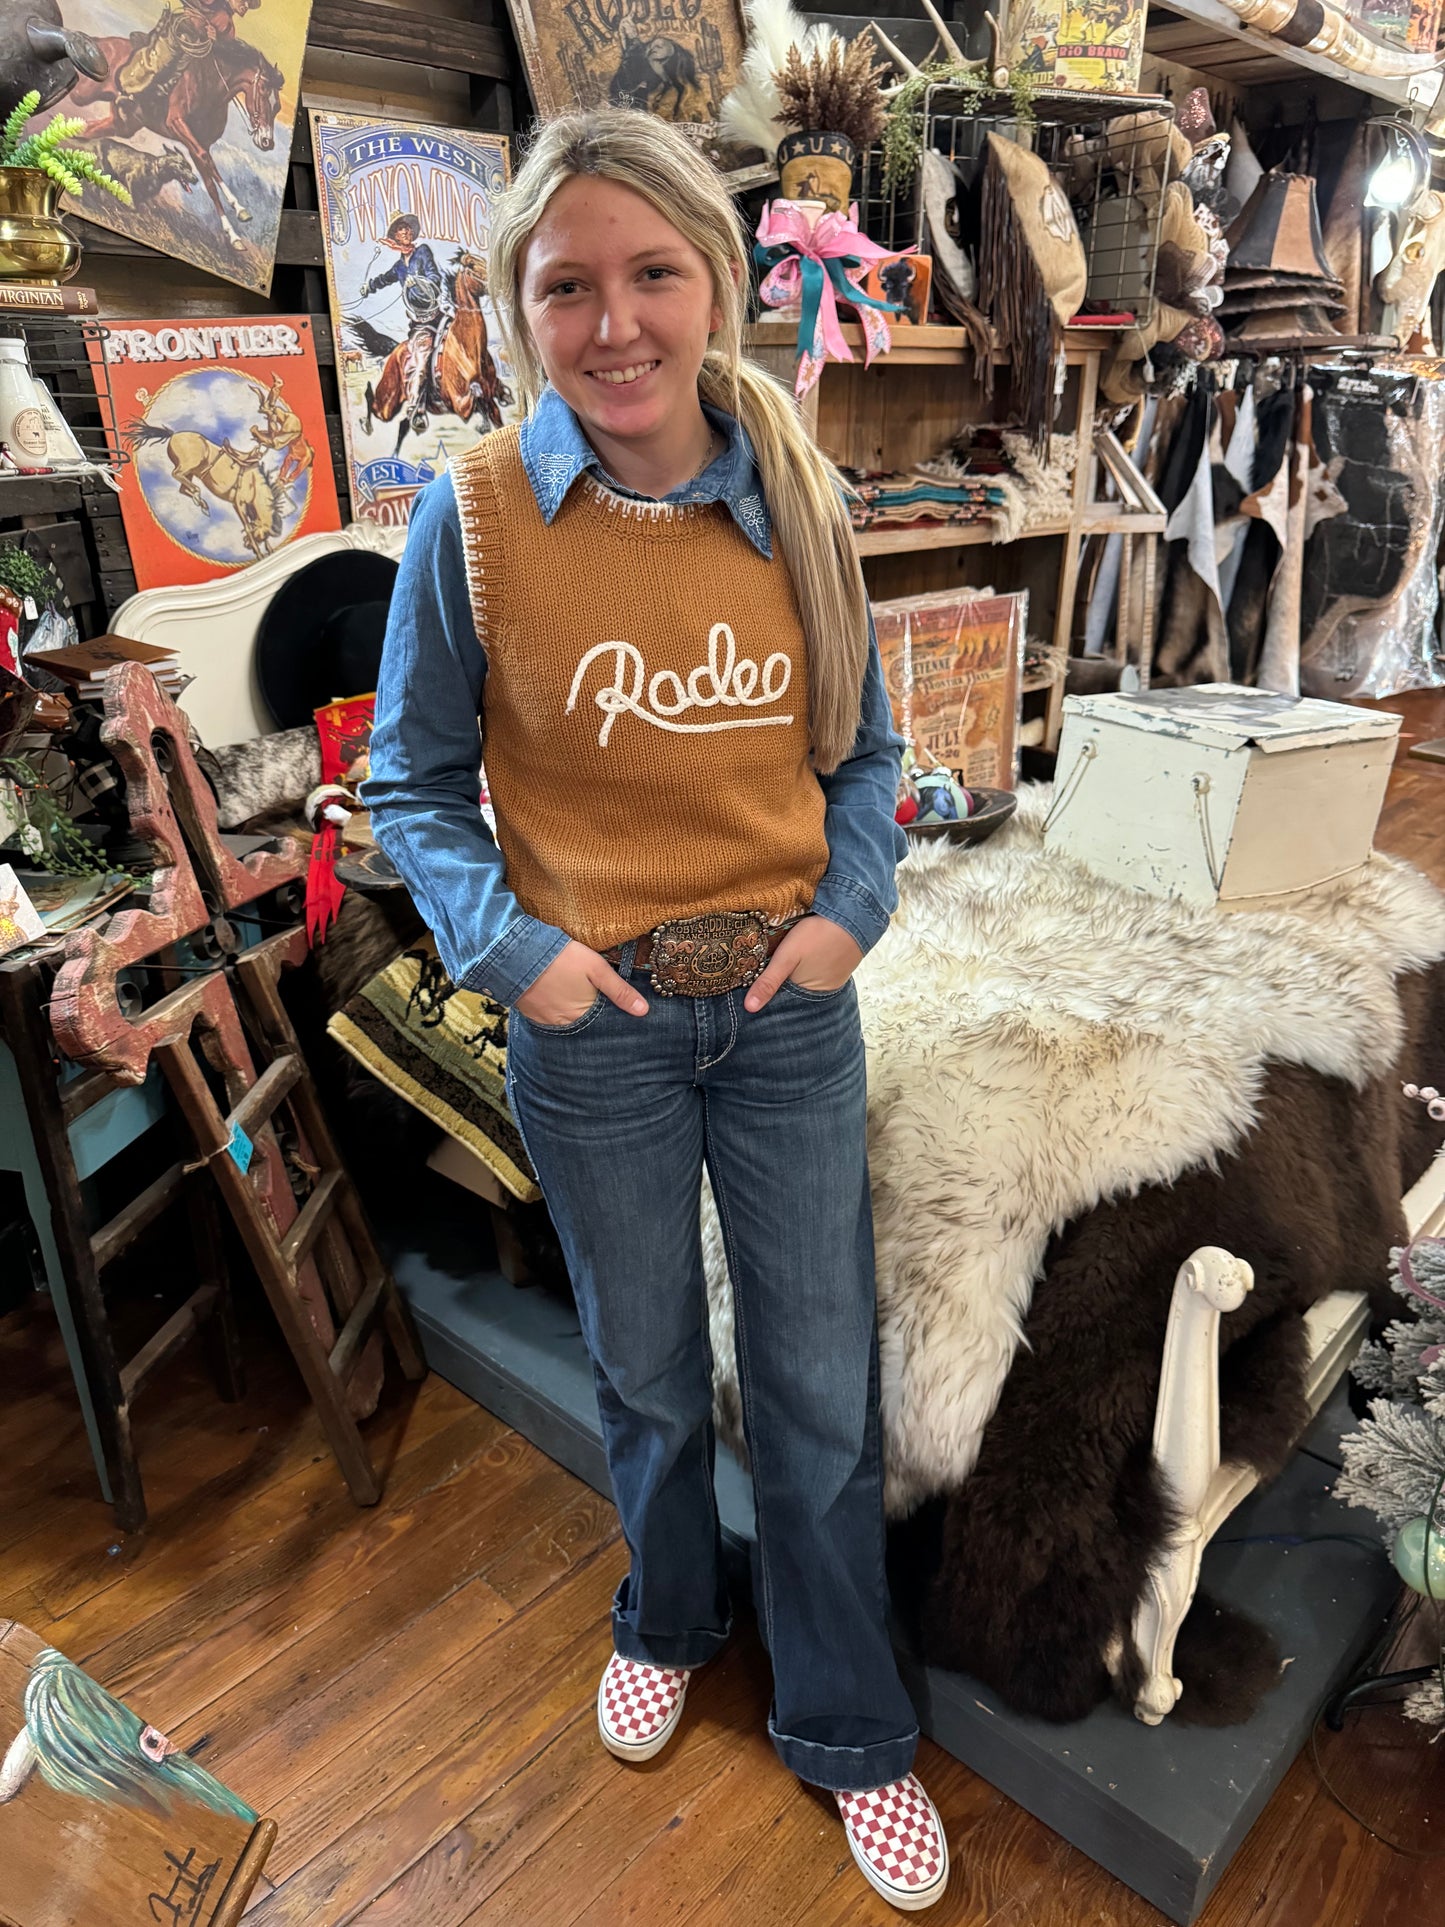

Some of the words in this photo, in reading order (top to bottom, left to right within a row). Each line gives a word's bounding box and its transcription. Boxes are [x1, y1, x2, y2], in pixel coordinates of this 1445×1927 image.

[1087, 46, 1126, 58] BRAVO
[350, 137, 403, 163] THE
[411, 137, 482, 178] WEST
[349, 163, 490, 250] WYOMING
[103, 324, 305, 363] FRONTIER
[371, 463, 401, 480] EST.
[565, 623, 793, 747] Rodeo
[889, 658, 950, 689] CEYENNE
[669, 925, 695, 935] ROBY
[697, 919, 733, 933] SADDLE
[679, 932, 710, 940] RANCH
[712, 930, 742, 939] RODEO
